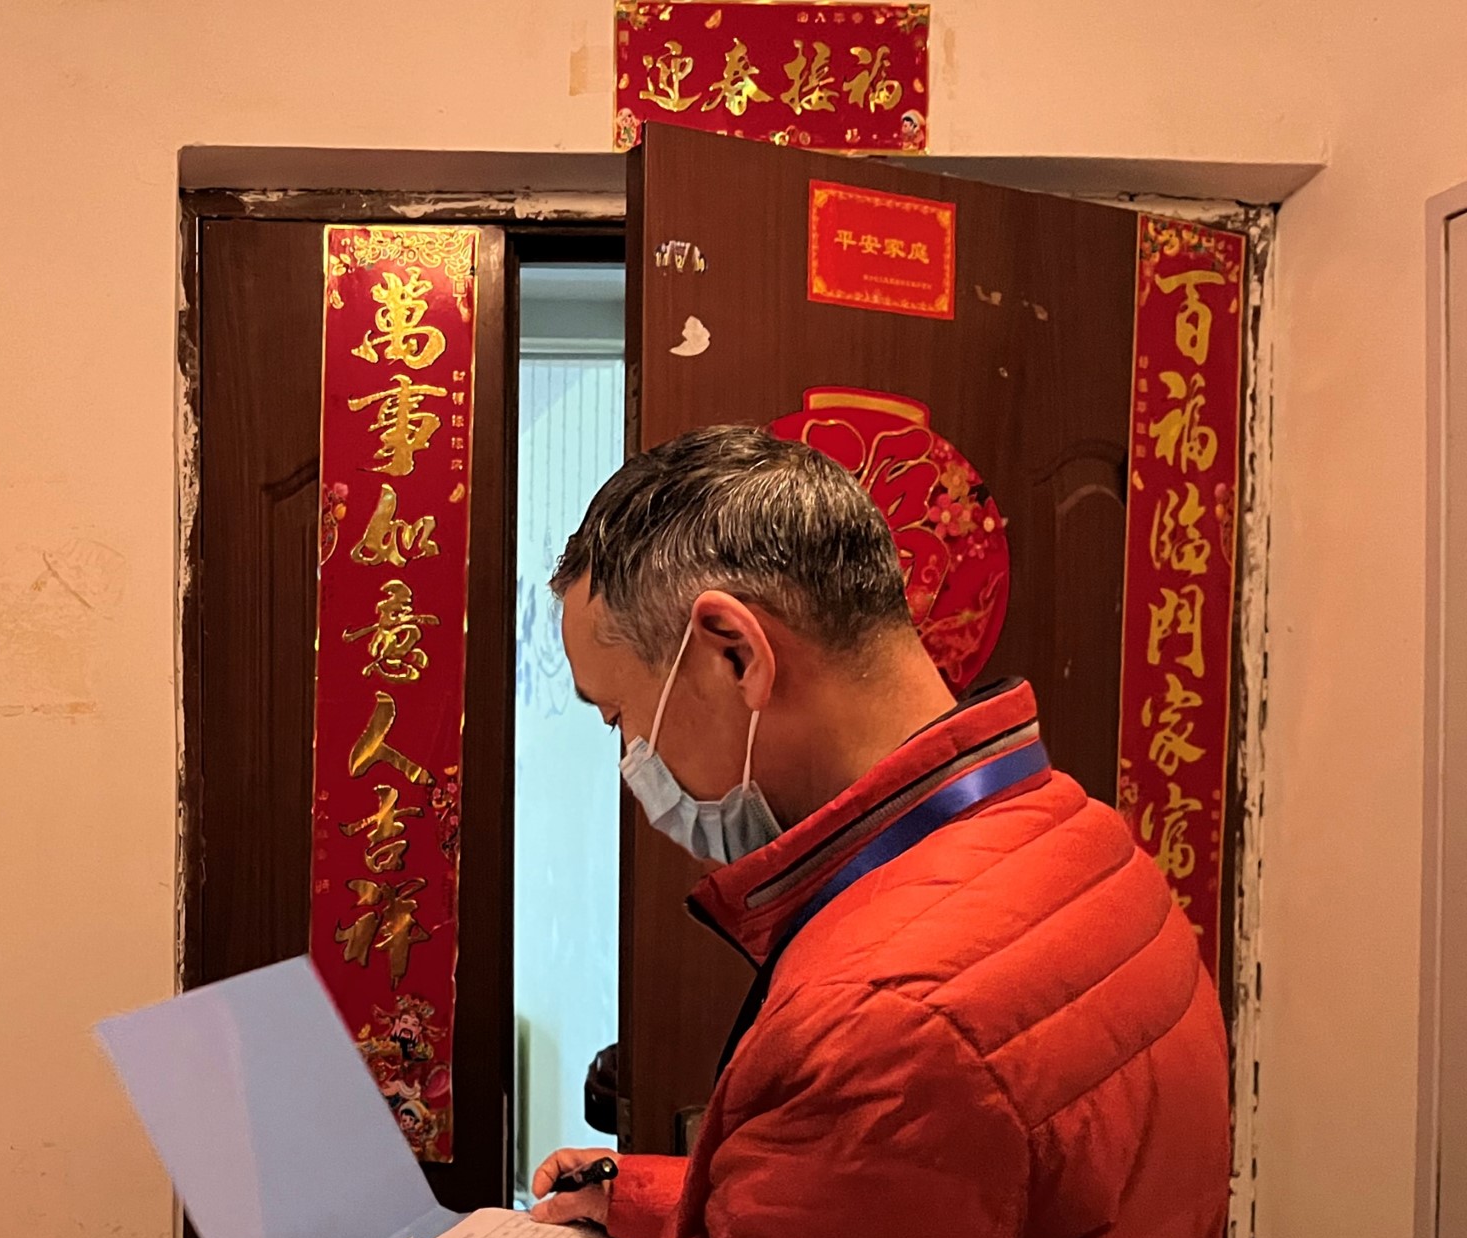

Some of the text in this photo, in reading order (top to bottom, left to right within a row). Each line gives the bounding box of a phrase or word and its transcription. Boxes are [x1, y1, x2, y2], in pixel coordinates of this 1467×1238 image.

[639, 38, 902, 116] 迎春接福
[834, 229, 930, 265] 平安家庭
[334, 267, 448, 991] 萬事如意人吉祥
